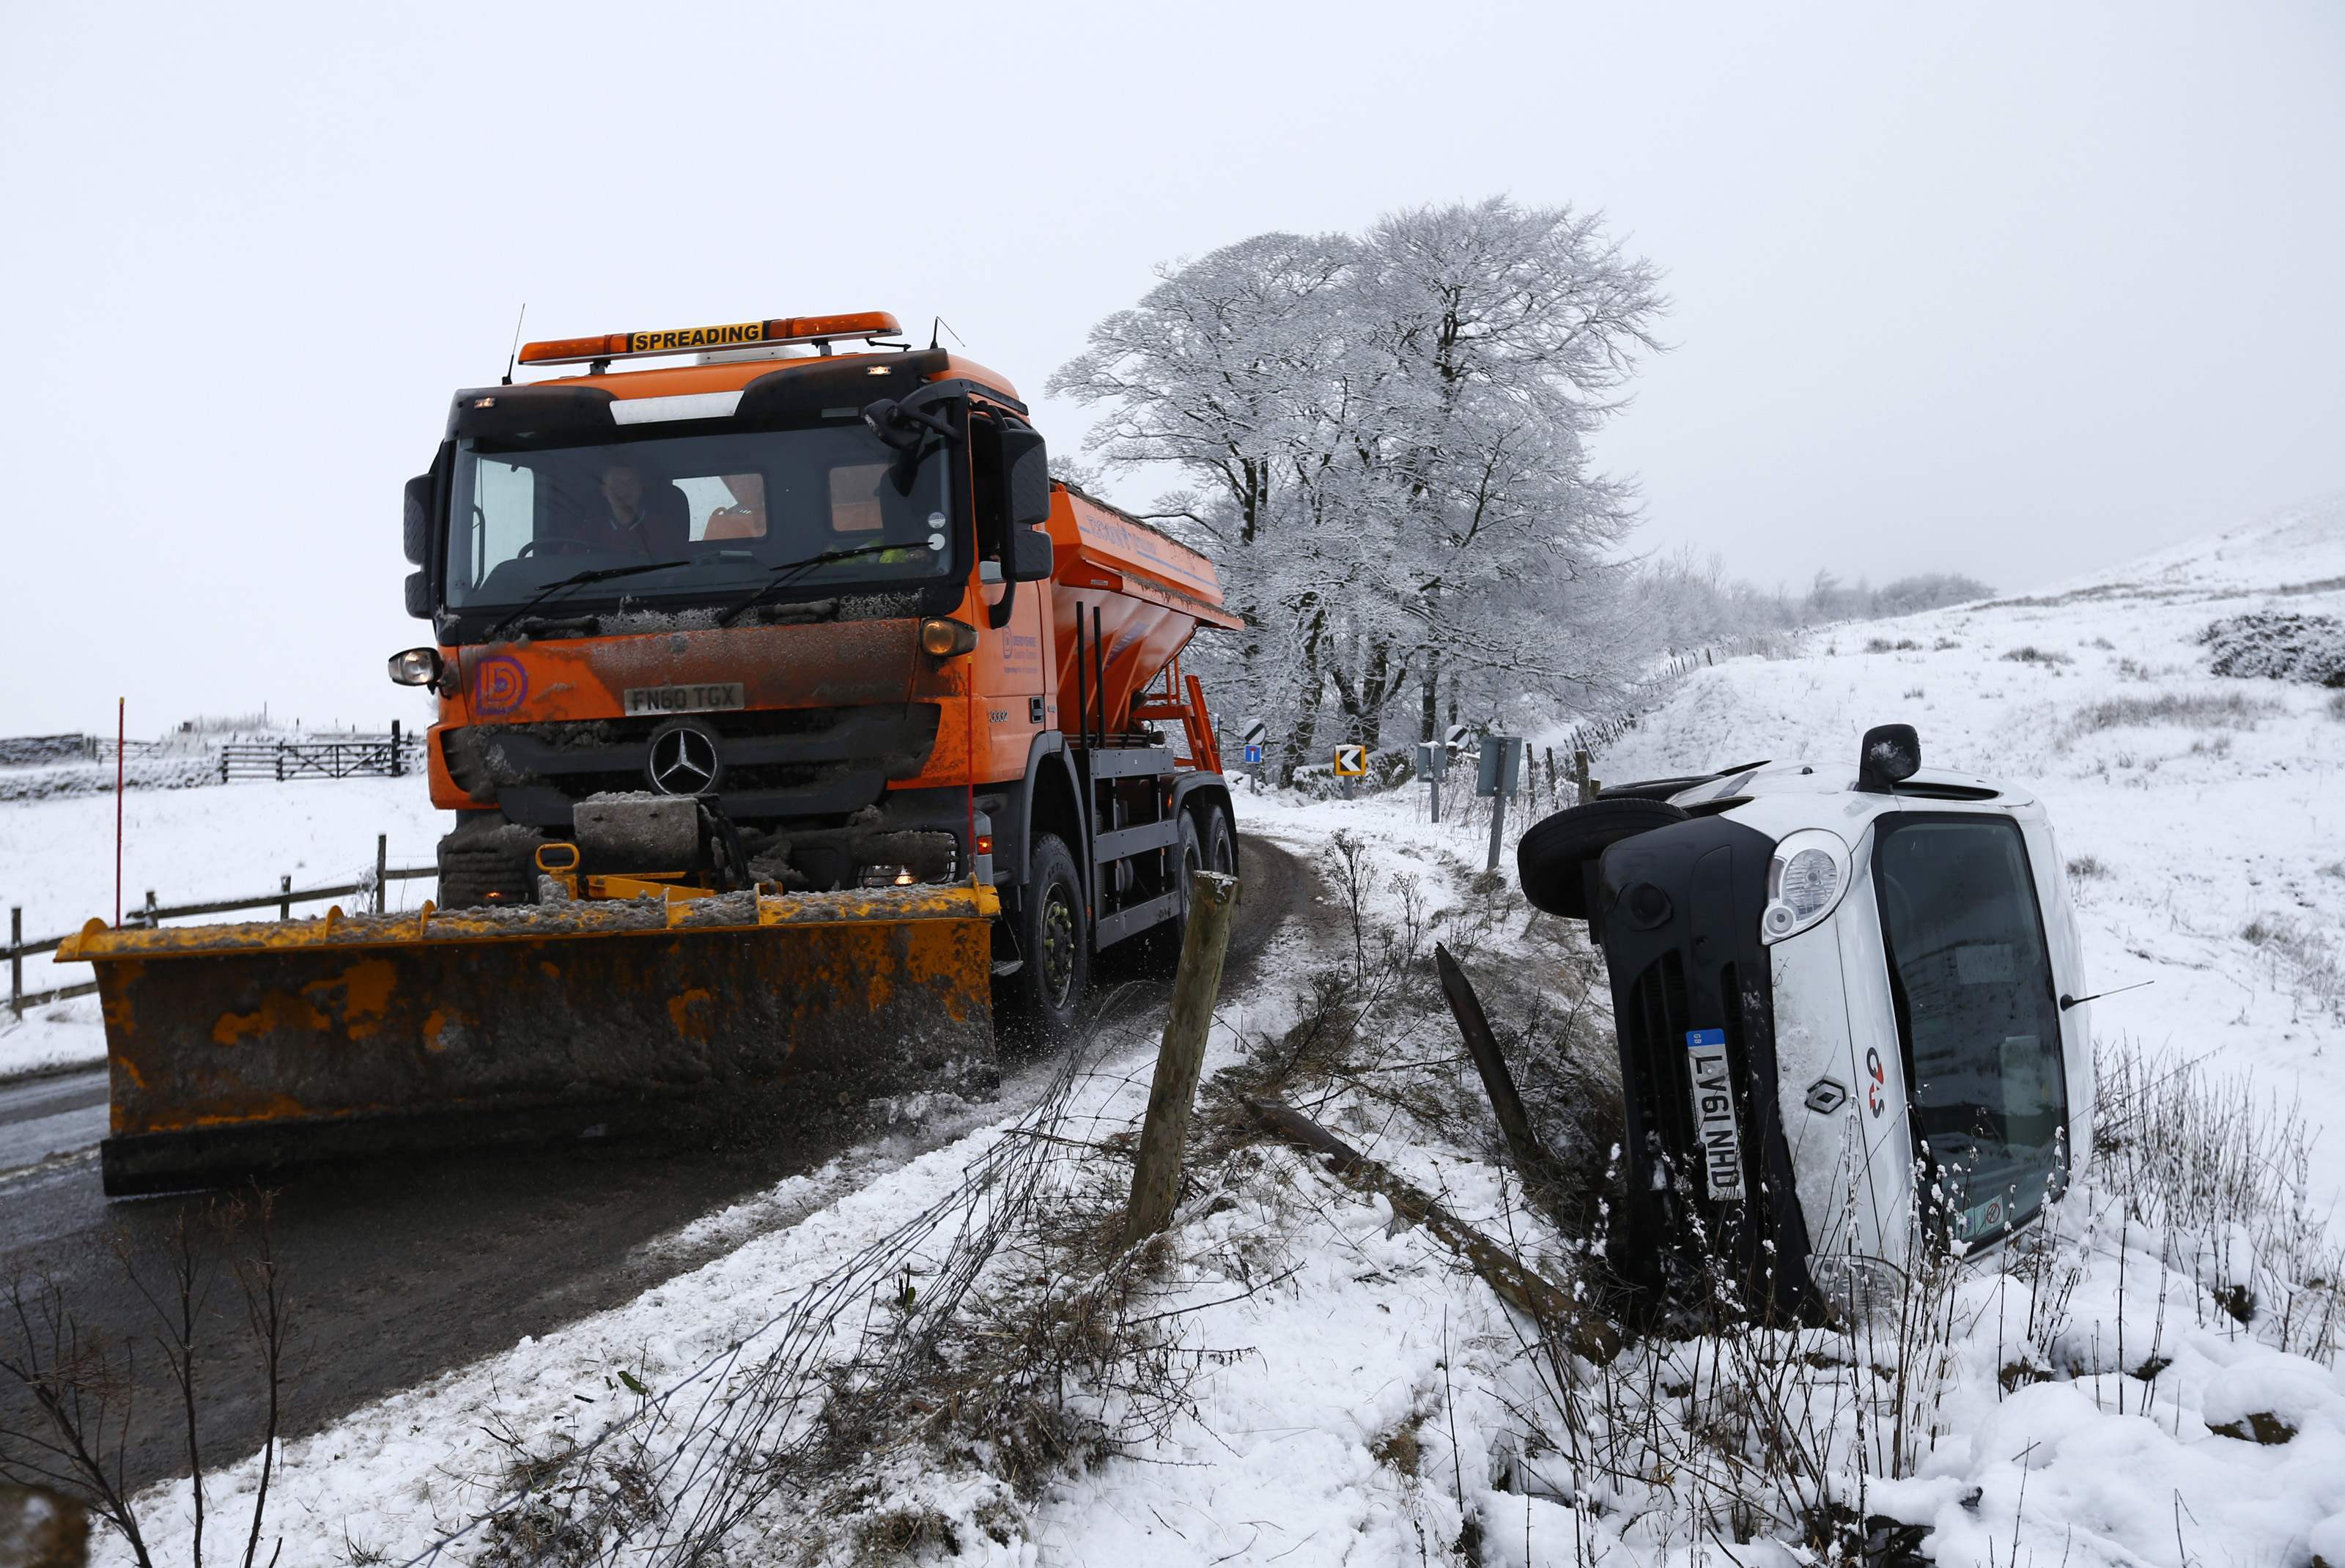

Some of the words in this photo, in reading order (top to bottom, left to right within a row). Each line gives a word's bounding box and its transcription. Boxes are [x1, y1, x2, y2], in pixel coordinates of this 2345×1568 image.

[635, 325, 759, 350] SPREADING
[632, 688, 687, 711] FN60
[693, 686, 736, 708] TGX
[1694, 1033, 1702, 1044] GB
[1866, 1047, 1885, 1119] G4S
